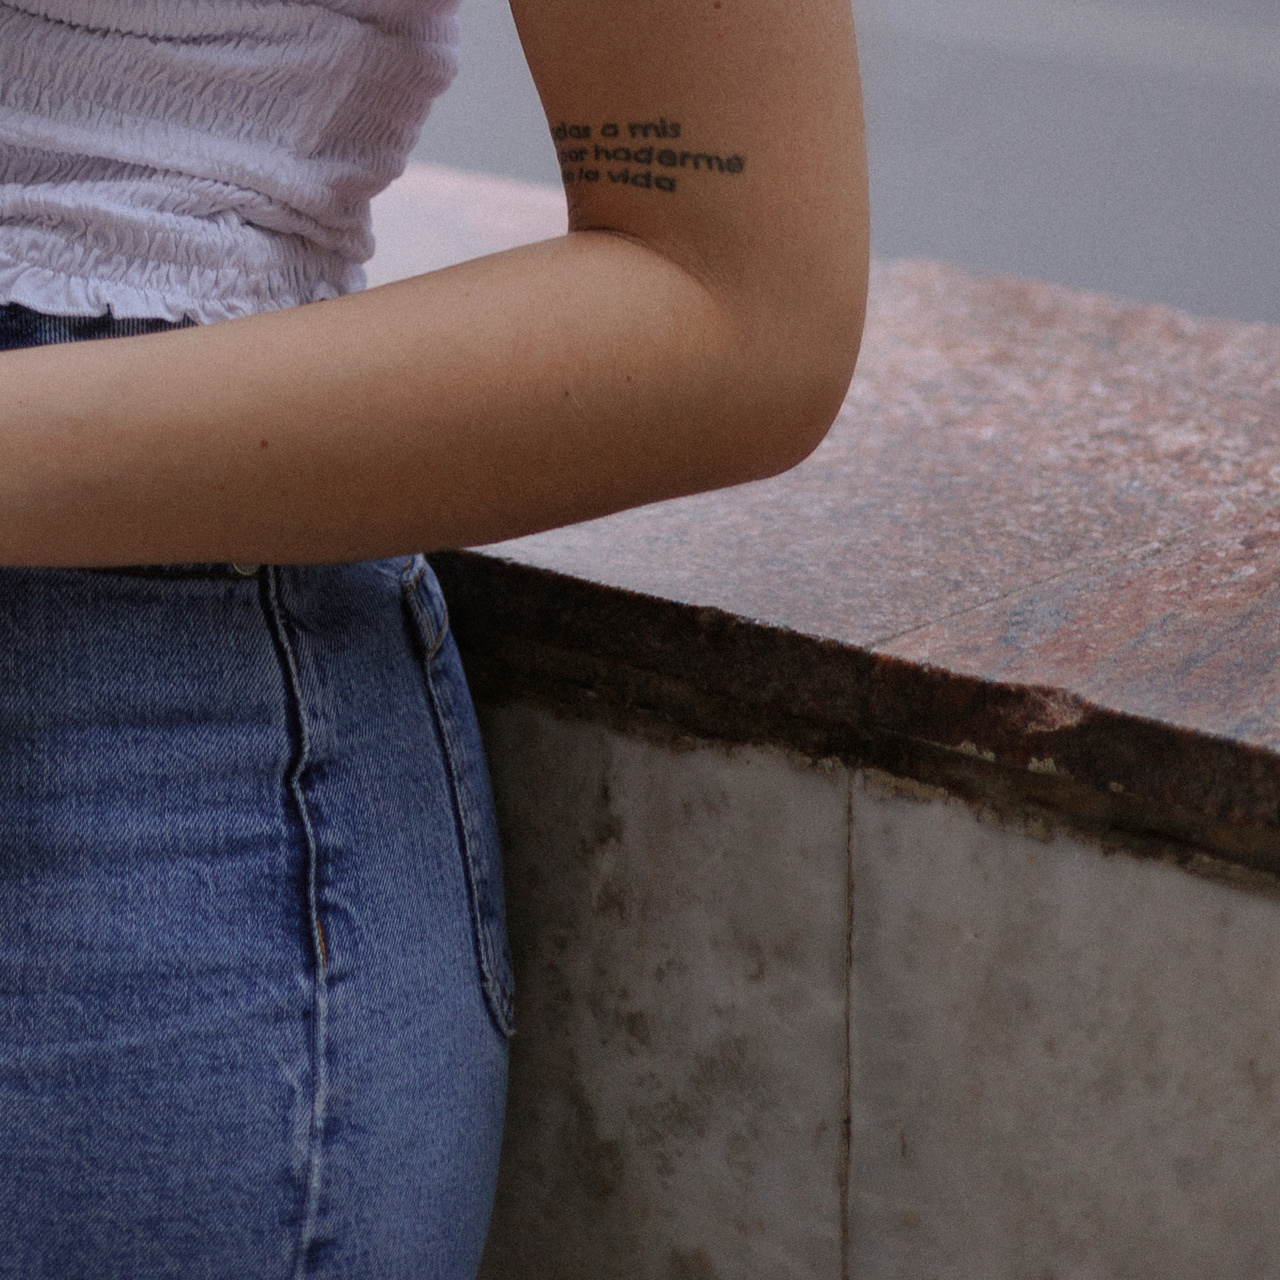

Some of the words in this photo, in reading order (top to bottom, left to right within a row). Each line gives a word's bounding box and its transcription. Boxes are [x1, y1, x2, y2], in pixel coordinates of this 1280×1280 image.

[600, 122, 619, 139] a
[627, 116, 682, 139] mis
[606, 169, 677, 192] vida
